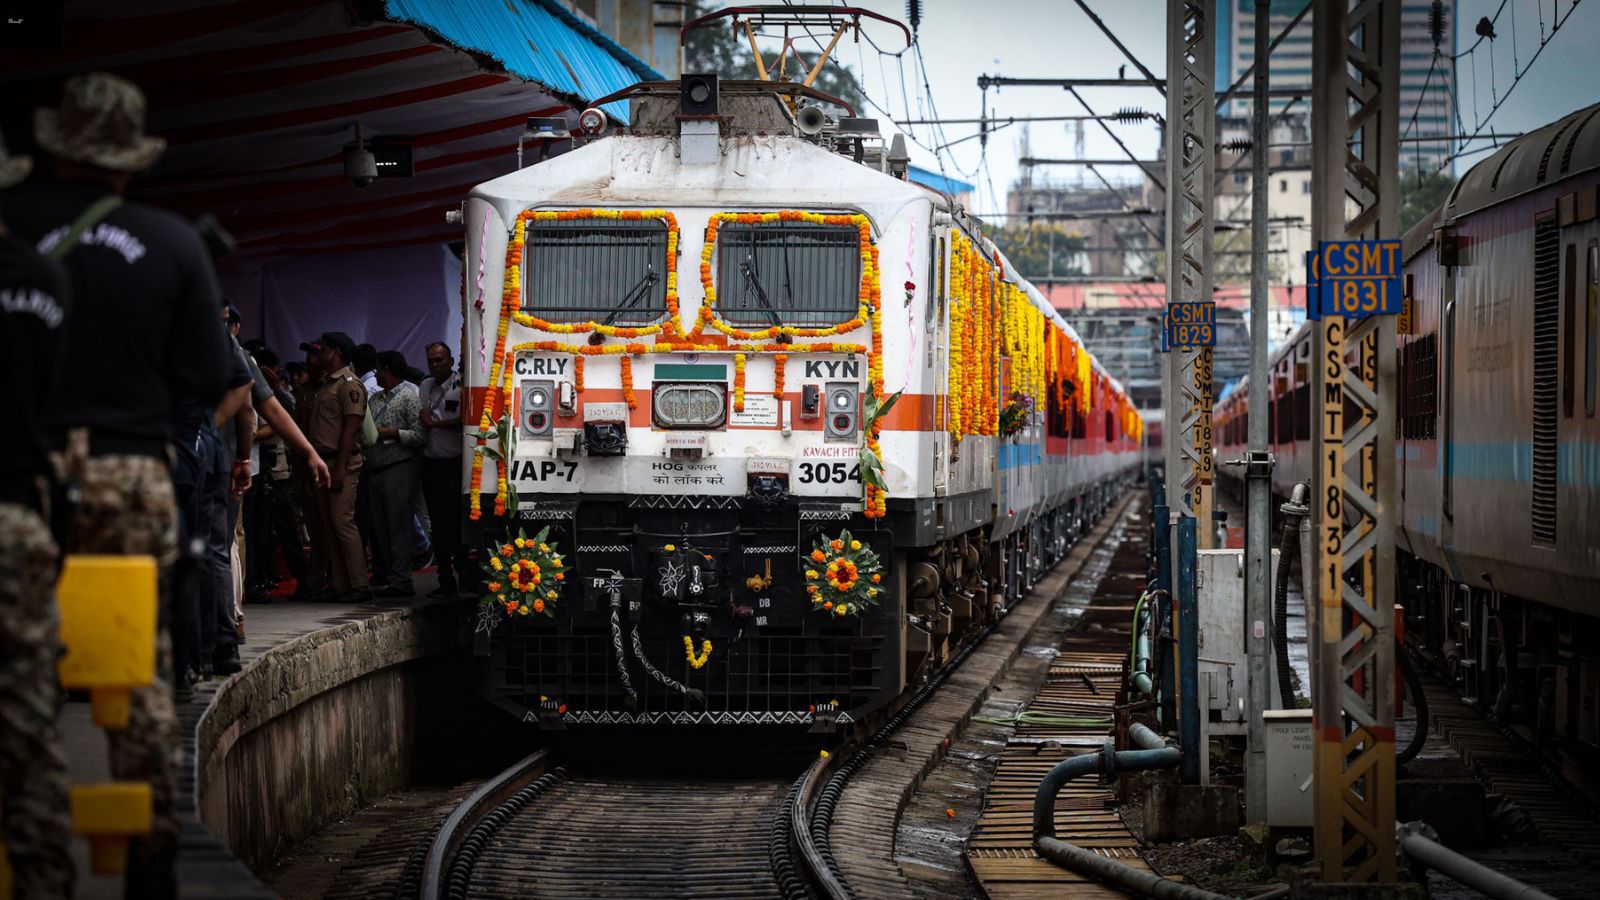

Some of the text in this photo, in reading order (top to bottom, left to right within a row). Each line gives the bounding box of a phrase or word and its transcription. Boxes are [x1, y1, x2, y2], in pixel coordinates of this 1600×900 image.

[1324, 243, 1400, 275] CSMT
[1333, 279, 1388, 313] 1831
[1170, 303, 1214, 322] CSMT
[1173, 325, 1212, 344] 1829
[515, 358, 568, 375] C.RLY
[805, 360, 859, 378] KYN
[1203, 350, 1212, 472] CSMT 1829
[803, 447, 839, 457] KAVACH
[1325, 322, 1341, 590] CSMT 1831
[652, 462, 684, 471] HOG
[653, 473, 670, 485] को
[593, 579, 605, 588] FP
[759, 599, 771, 607] DB
